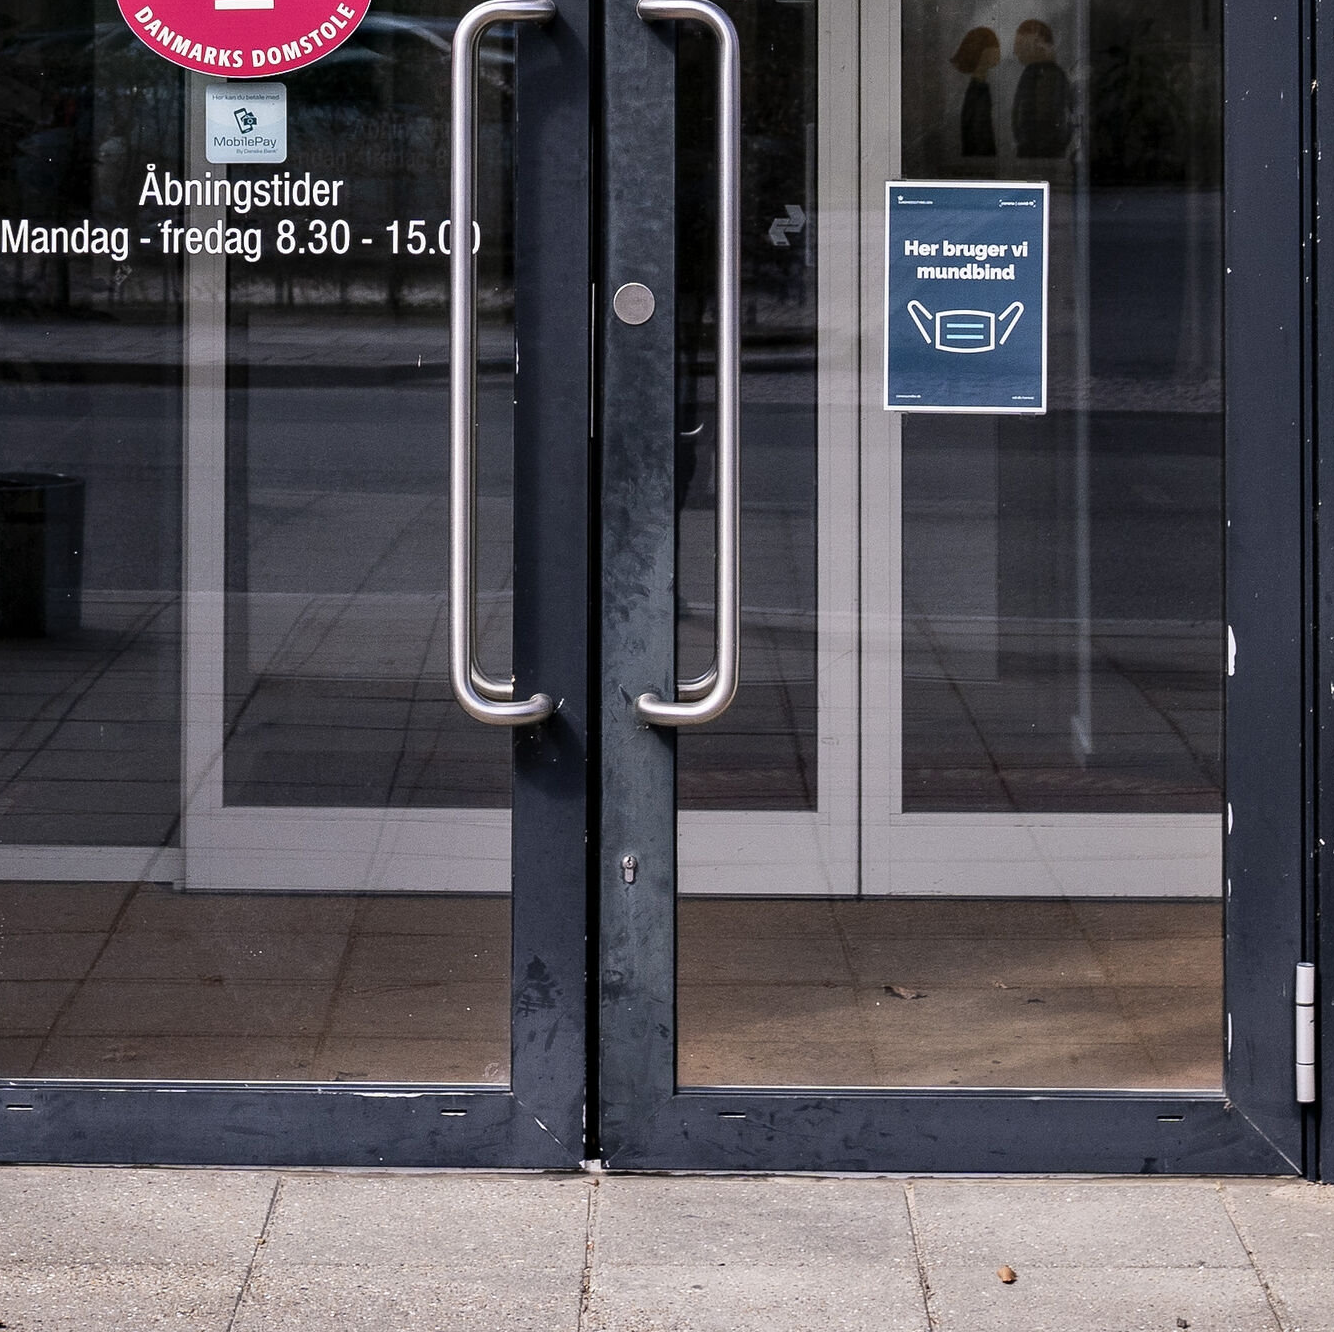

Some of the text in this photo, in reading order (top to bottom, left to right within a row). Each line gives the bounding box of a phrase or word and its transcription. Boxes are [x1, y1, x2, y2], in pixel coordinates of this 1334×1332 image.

[134, 2, 356, 68] DANMARKS DOMSTOLE
[213, 136, 277, 148] MobilePay
[138, 163, 344, 214] Åbningstider
[1, 219, 129, 262] Mandag
[160, 219, 262, 263] fredag
[276, 219, 351, 255] 8.30
[904, 239, 1028, 261] Her bruger vi
[917, 262, 1016, 281] mundbind
